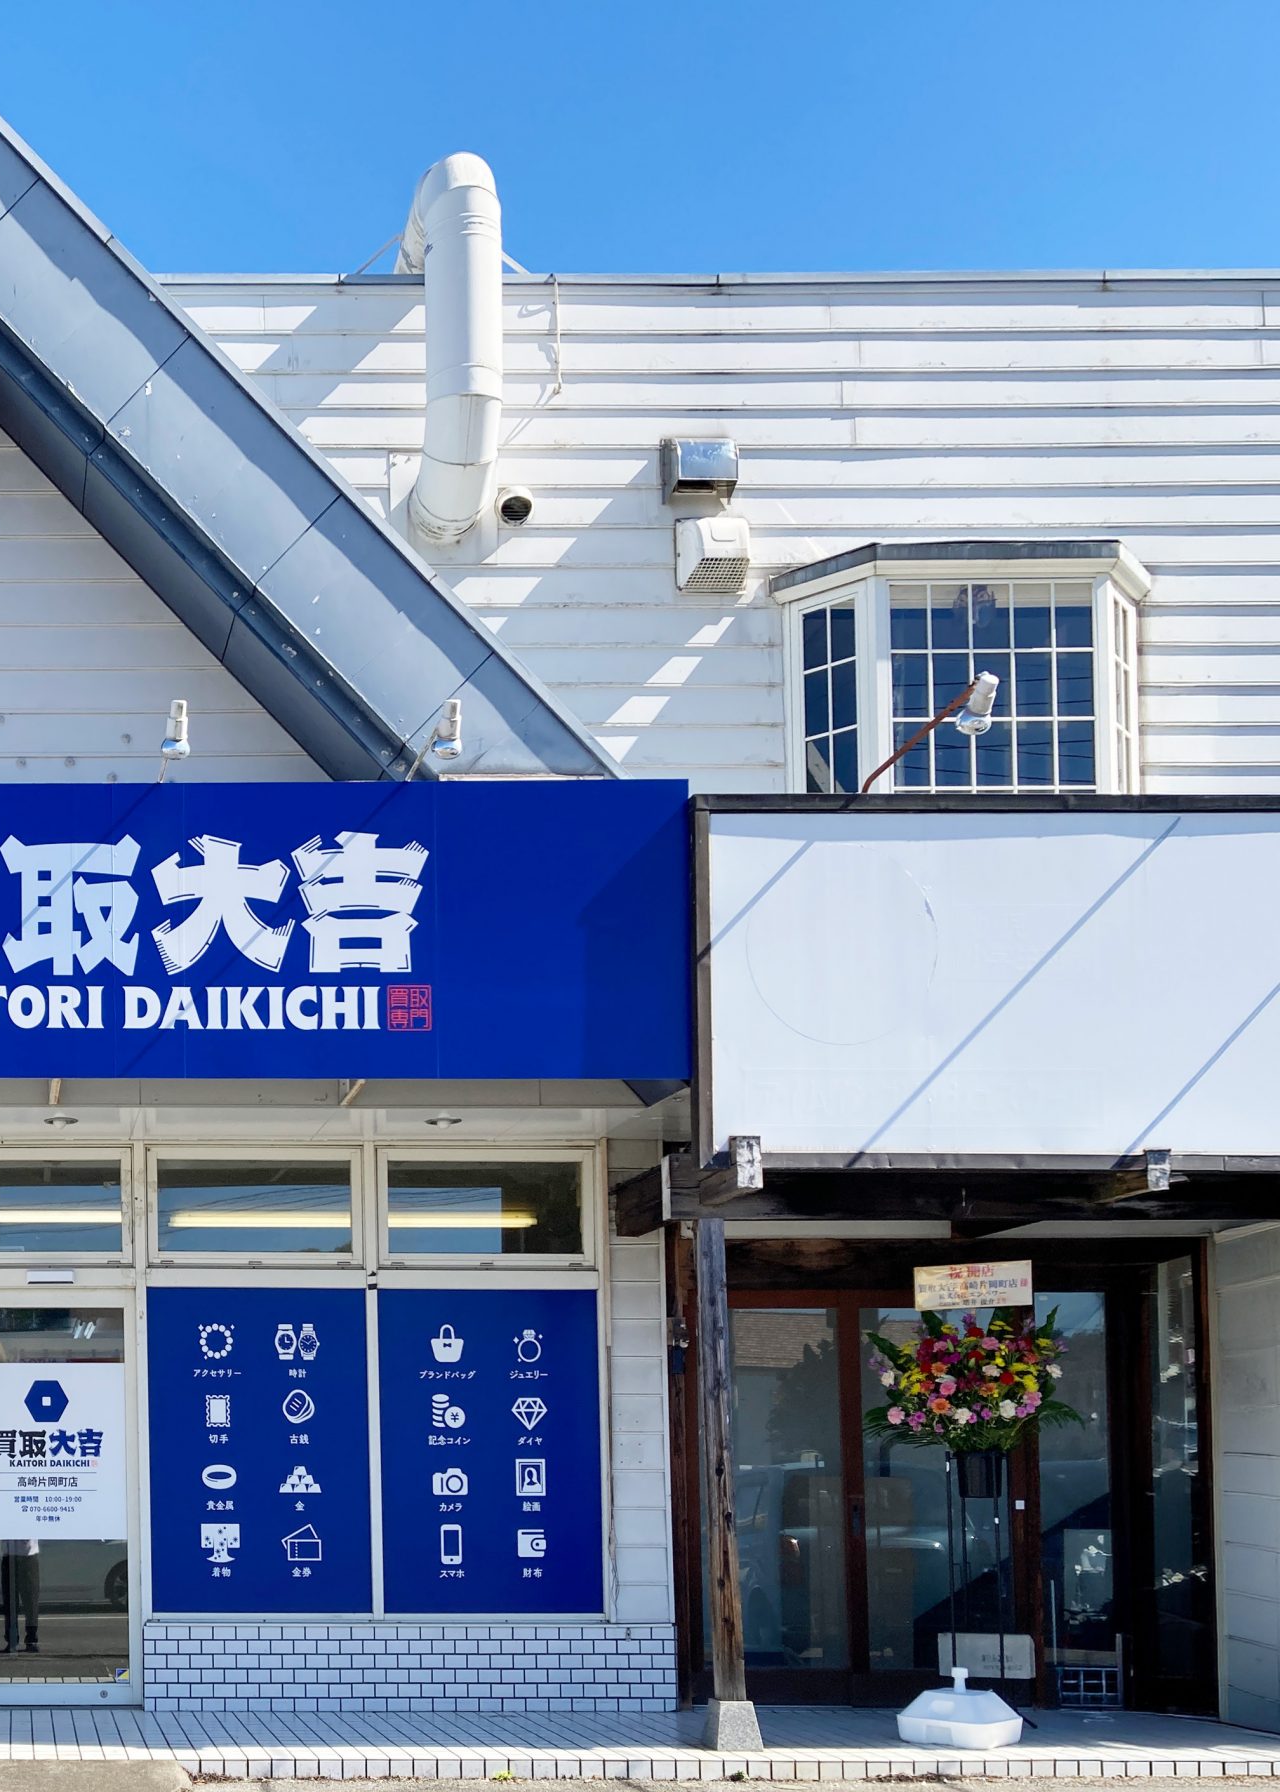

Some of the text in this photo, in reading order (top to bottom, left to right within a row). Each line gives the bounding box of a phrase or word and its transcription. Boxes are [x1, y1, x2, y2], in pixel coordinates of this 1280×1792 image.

[122, 984, 381, 1029] DAIKICHI
[193, 1368, 242, 1378] アクセサリー
[288, 1368, 307, 1378] 時計
[419, 1370, 477, 1380] ブランドバッグ
[509, 1370, 549, 1380] ジュエリー
[208, 1434, 229, 1444] 切手
[289, 1434, 310, 1444] 古銭
[428, 1435, 471, 1446] 記念コイン
[517, 1436, 543, 1446] ダイヤ
[9, 1459, 47, 1468] KAITORI
[49, 1459, 90, 1468] DAIKICHI
[17, 1476, 78, 1488] 高崎片岡町店
[206, 1500, 234, 1511] 貴金属
[294, 1500, 305, 1511] 金
[439, 1502, 463, 1512] カメラ
[522, 1501, 541, 1512] 絵画
[211, 1567, 231, 1577] 着物
[291, 1567, 312, 1577] 金券
[439, 1569, 465, 1579] スマホ
[522, 1568, 543, 1578] 財布
